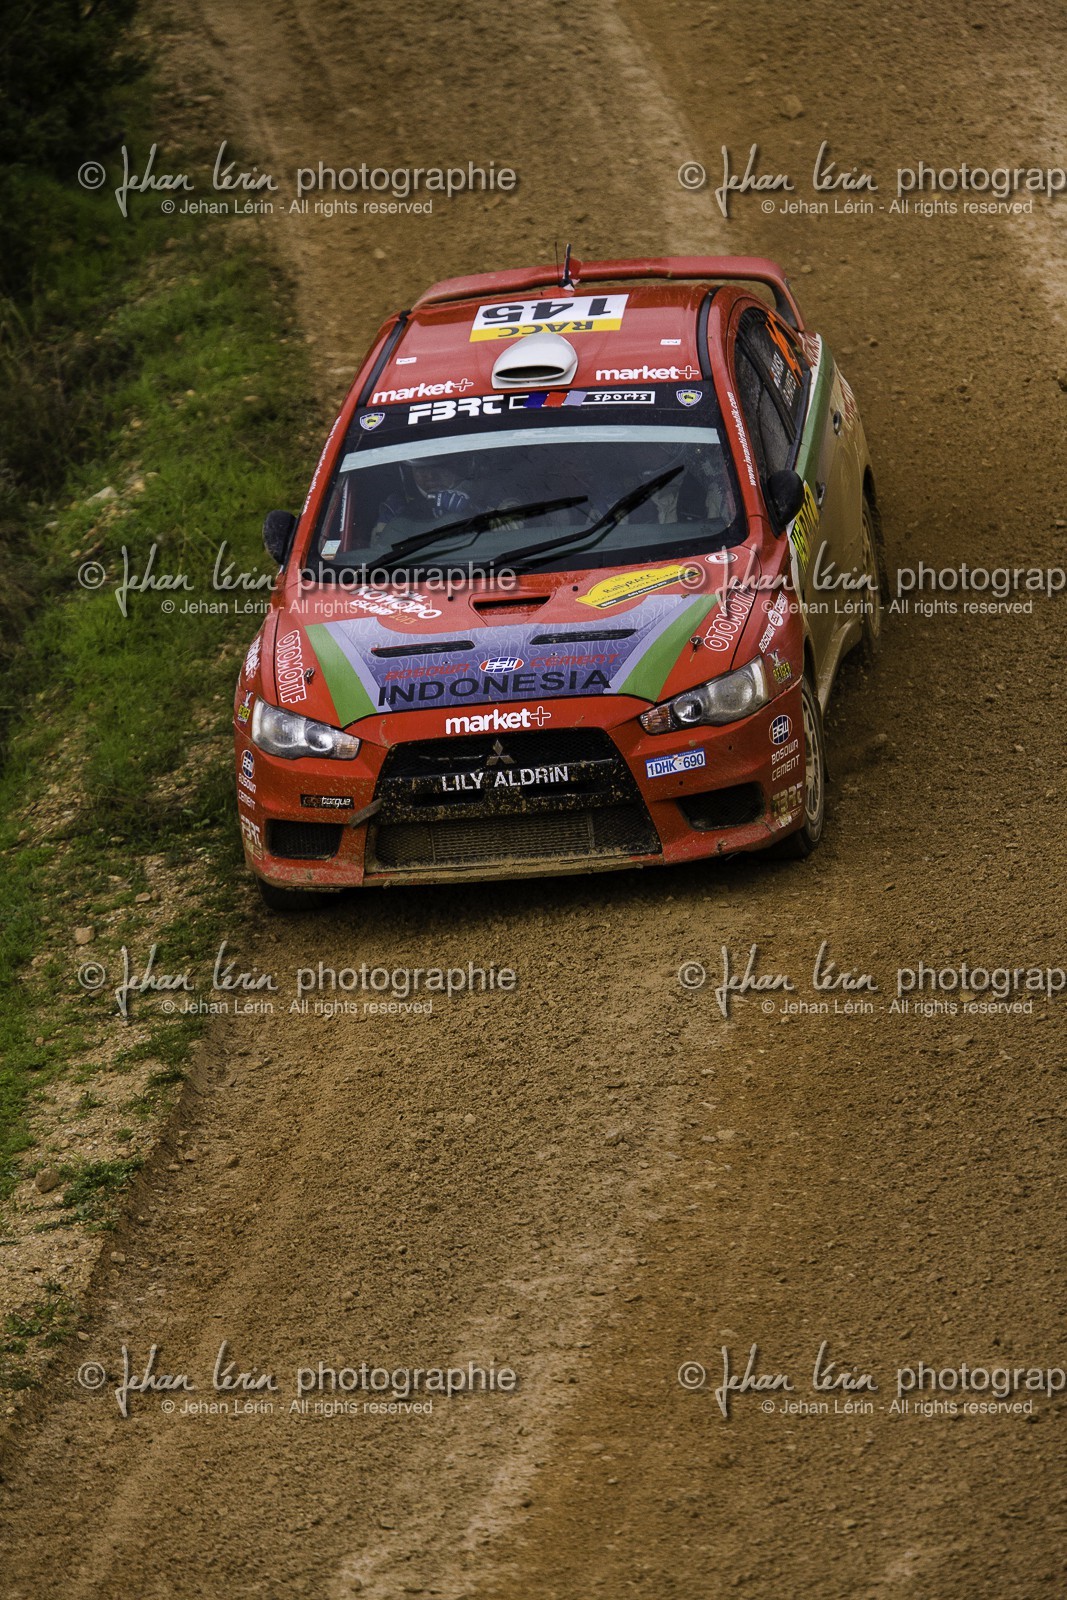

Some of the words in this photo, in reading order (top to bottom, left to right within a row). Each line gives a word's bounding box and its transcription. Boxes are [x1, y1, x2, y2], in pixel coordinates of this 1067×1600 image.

[482, 298, 612, 326] 145
[498, 320, 594, 338] RACC
[594, 393, 647, 402] sports
[276, 629, 307, 704] OTOMOTIF
[378, 670, 612, 707] INDONESIA
[683, 753, 704, 769] 690
[771, 754, 800, 782] CEMENT
[441, 772, 484, 792] LILY
